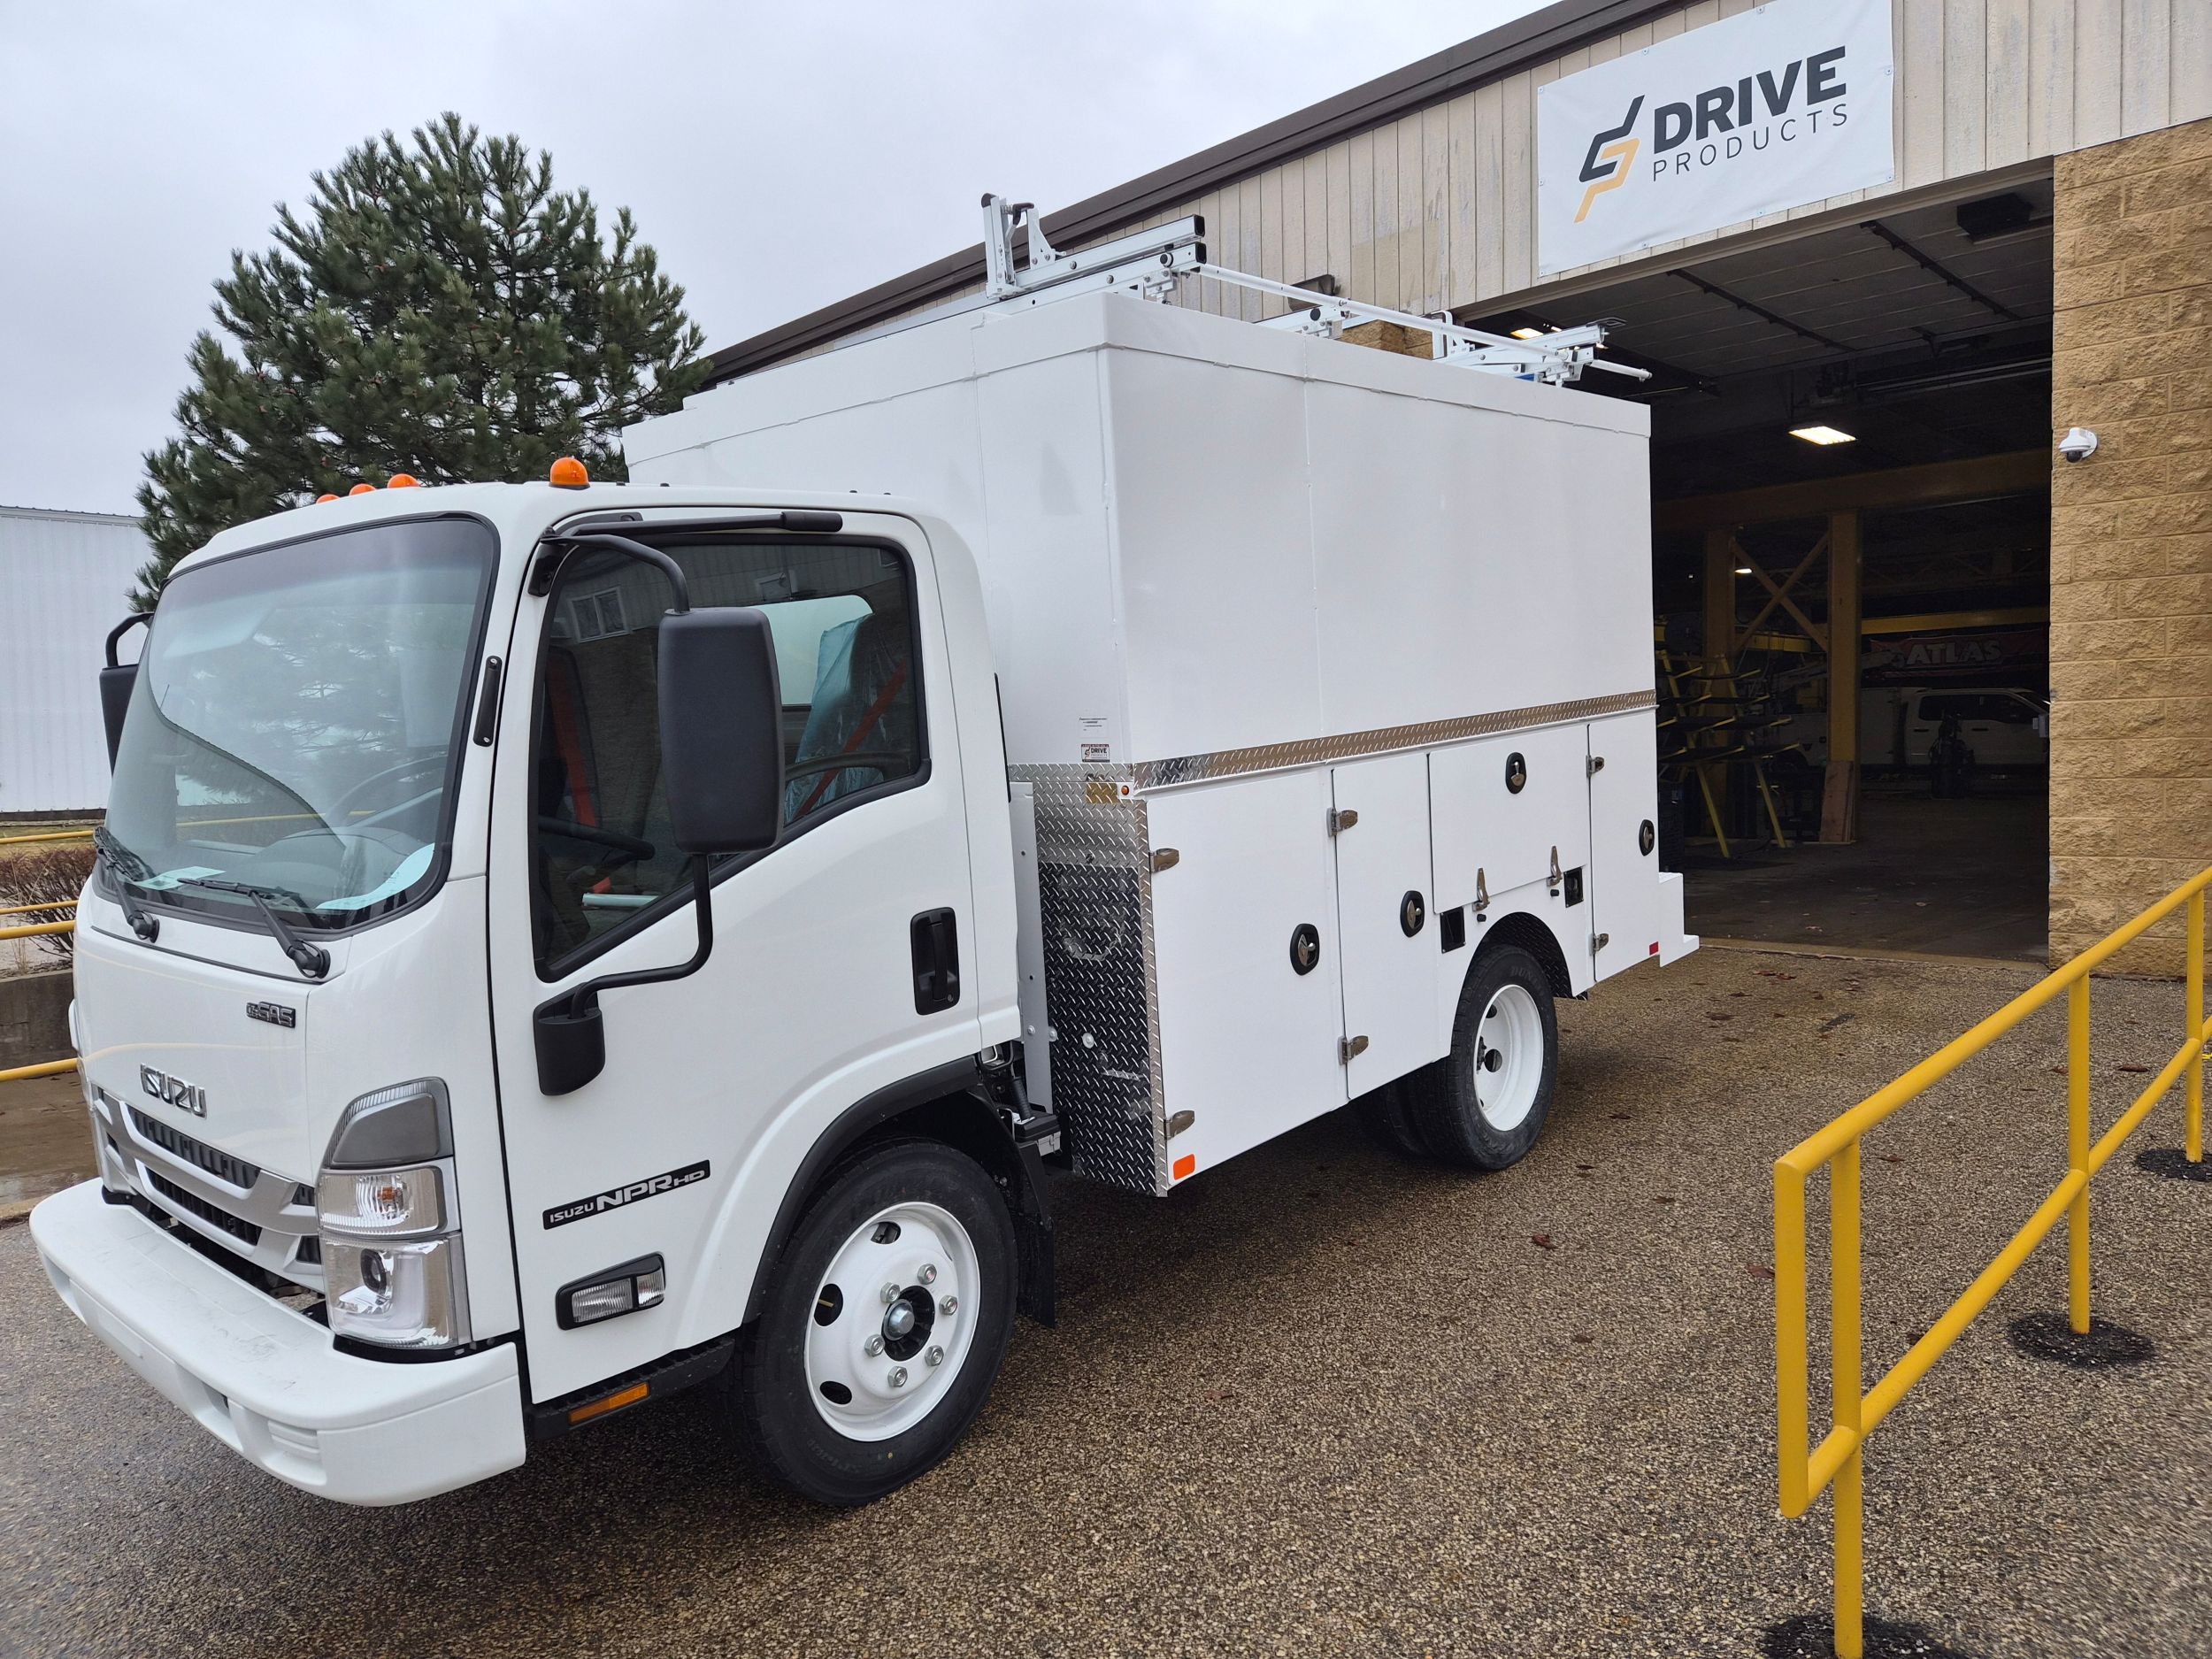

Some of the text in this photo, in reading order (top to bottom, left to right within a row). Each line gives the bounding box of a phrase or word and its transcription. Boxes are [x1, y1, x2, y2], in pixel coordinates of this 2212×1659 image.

[1654, 45, 1847, 155] DRIVE
[1653, 104, 1848, 181] PRODUCTS
[1905, 639, 2003, 664] ATLAS
[140, 1063, 207, 1118] ISUZU
[549, 1170, 705, 1224] ISUZU NPR HD
